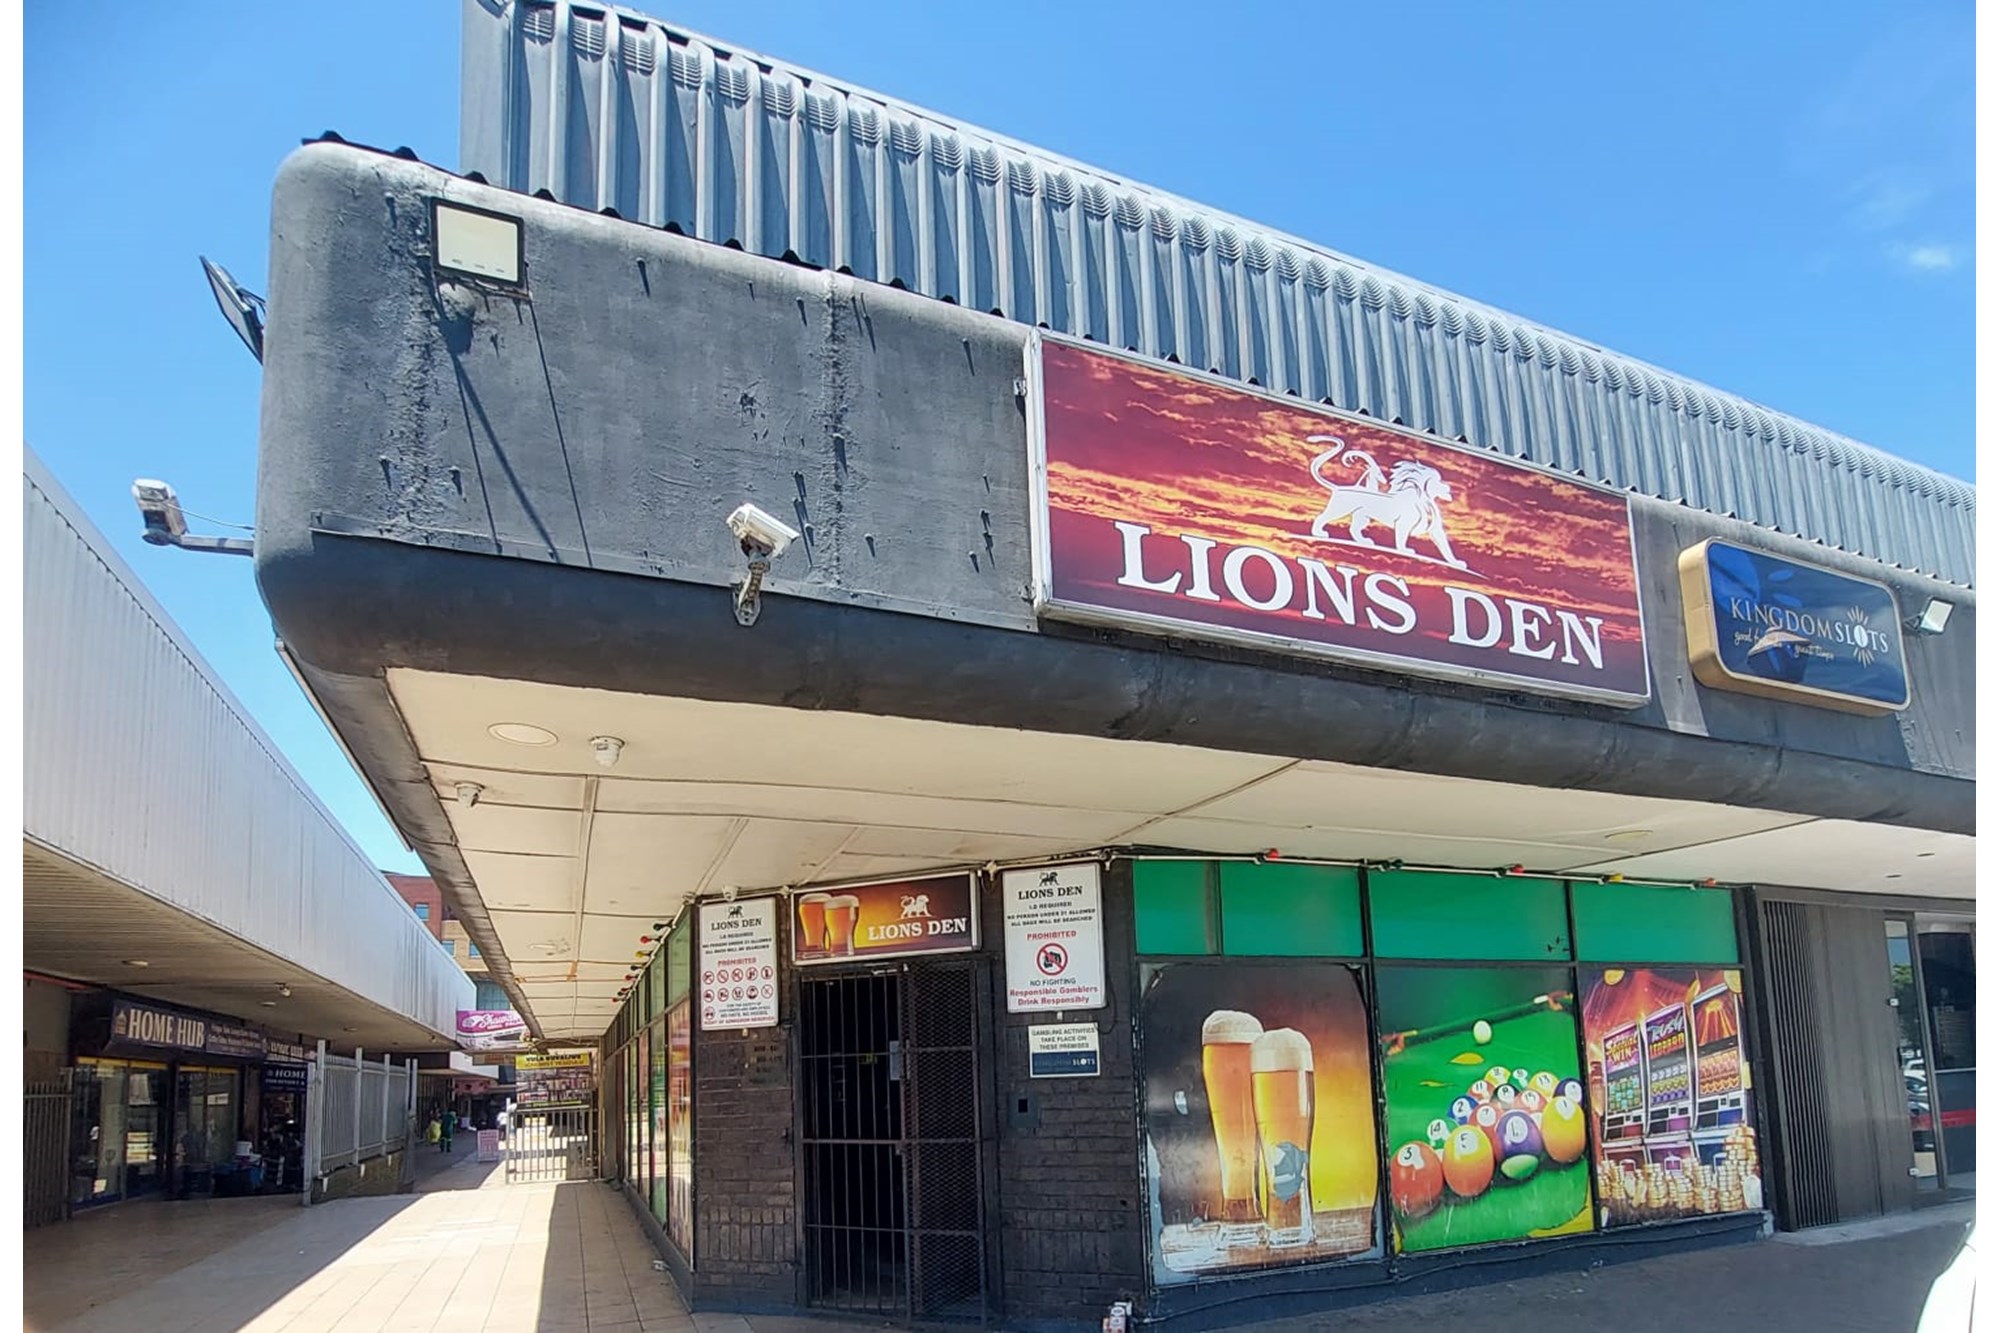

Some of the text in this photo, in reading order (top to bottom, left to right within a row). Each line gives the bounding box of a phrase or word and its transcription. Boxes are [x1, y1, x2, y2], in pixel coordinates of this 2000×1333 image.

[1114, 521, 1605, 670] LIONS DEN
[1018, 885, 1083, 900] LIONS DEN
[1069, 907, 1096, 915] ALLOWED
[711, 917, 762, 931] LIONS DEN
[867, 917, 967, 940] LIONS DEN
[1026, 930, 1077, 940] PROHIBITED
[1042, 978, 1076, 986] FIGHTING
[1010, 986, 1098, 997] Responsible Gamblers
[1018, 996, 1089, 1006] Drink Responsibly
[128, 1008, 174, 1043] HOME
[177, 1018, 205, 1048] HUB
[1063, 1027, 1096, 1035] ACTIVITIES
[275, 1068, 306, 1079] HOME
[1457, 1101, 1463, 1112] 2
[1403, 1146, 1412, 1160] 3
